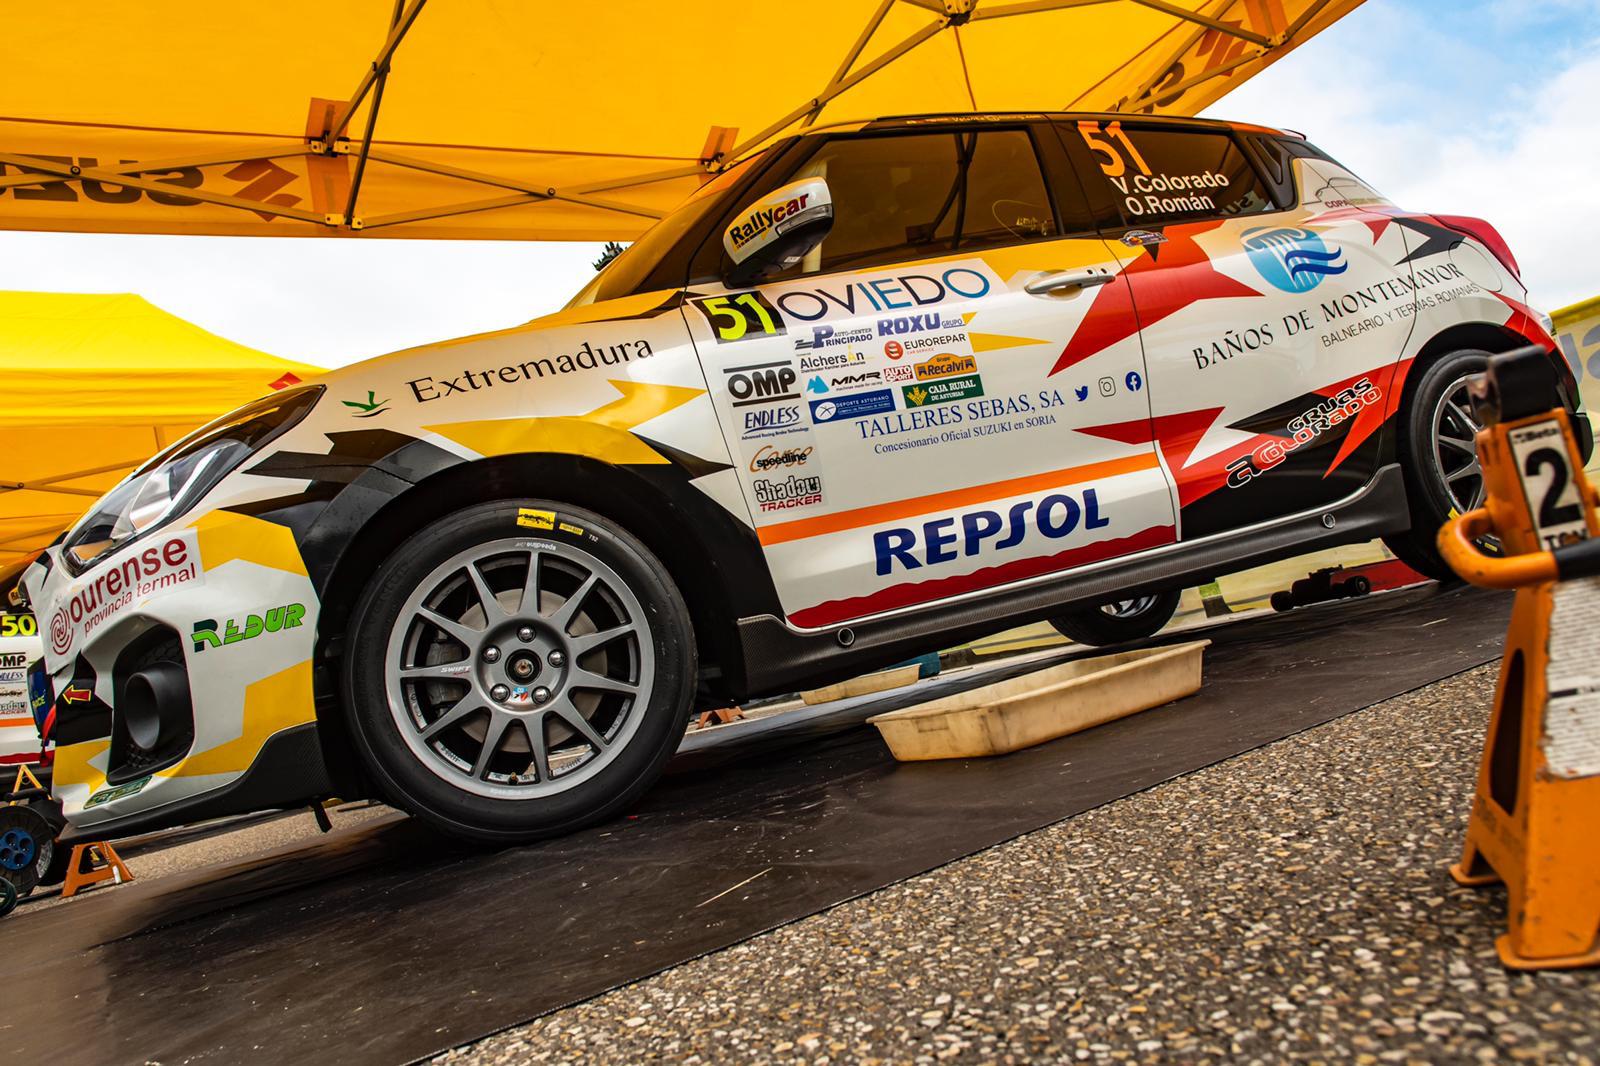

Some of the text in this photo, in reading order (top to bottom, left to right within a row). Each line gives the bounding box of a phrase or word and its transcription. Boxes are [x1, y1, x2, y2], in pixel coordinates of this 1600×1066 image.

[1077, 121, 1152, 176] 51
[1110, 171, 1230, 195] V.Colorado
[1125, 192, 1216, 216] O.Román
[729, 193, 809, 245] Rallycar
[777, 268, 990, 321] OVIEDO
[702, 292, 776, 340] 51
[877, 313, 963, 336] ROXU GRUPO
[1192, 262, 1465, 370] BAÑOS DE MONTEMAYOR
[1321, 283, 1480, 348] BALNEARIO Y TERMAS ROMANAS
[834, 328, 872, 337] AUTO-CENTER
[904, 333, 966, 349] EUROREPAR
[405, 340, 655, 403] Extremadura
[831, 372, 881, 386] MMR
[884, 366, 911, 377] AUTO
[886, 374, 912, 383] SPORT
[927, 360, 964, 376] Recalvi
[728, 367, 796, 399] OMP
[928, 379, 976, 395] CAJA RURAL
[940, 390, 964, 399] ASTURIAS
[836, 394, 890, 408] DEPORTE ASTURIANO
[745, 405, 799, 429] ENDLESS
[856, 390, 1065, 440] TALLERES SEBAS, SA
[874, 414, 1056, 454] Concesionario Oficial SUZUKI en SORIA
[756, 452, 807, 469] speedline
[753, 475, 821, 503] Shadow
[1525, 447, 1583, 528] 2
[760, 494, 822, 512] TRACKER
[873, 488, 1110, 577] REPSOL
[70, 538, 188, 623] ourense
[84, 562, 196, 638] provincia termal
[1, 615, 37, 637] 50
[0, 655, 26, 667] MP
[441, 665, 472, 673] SWIFT
